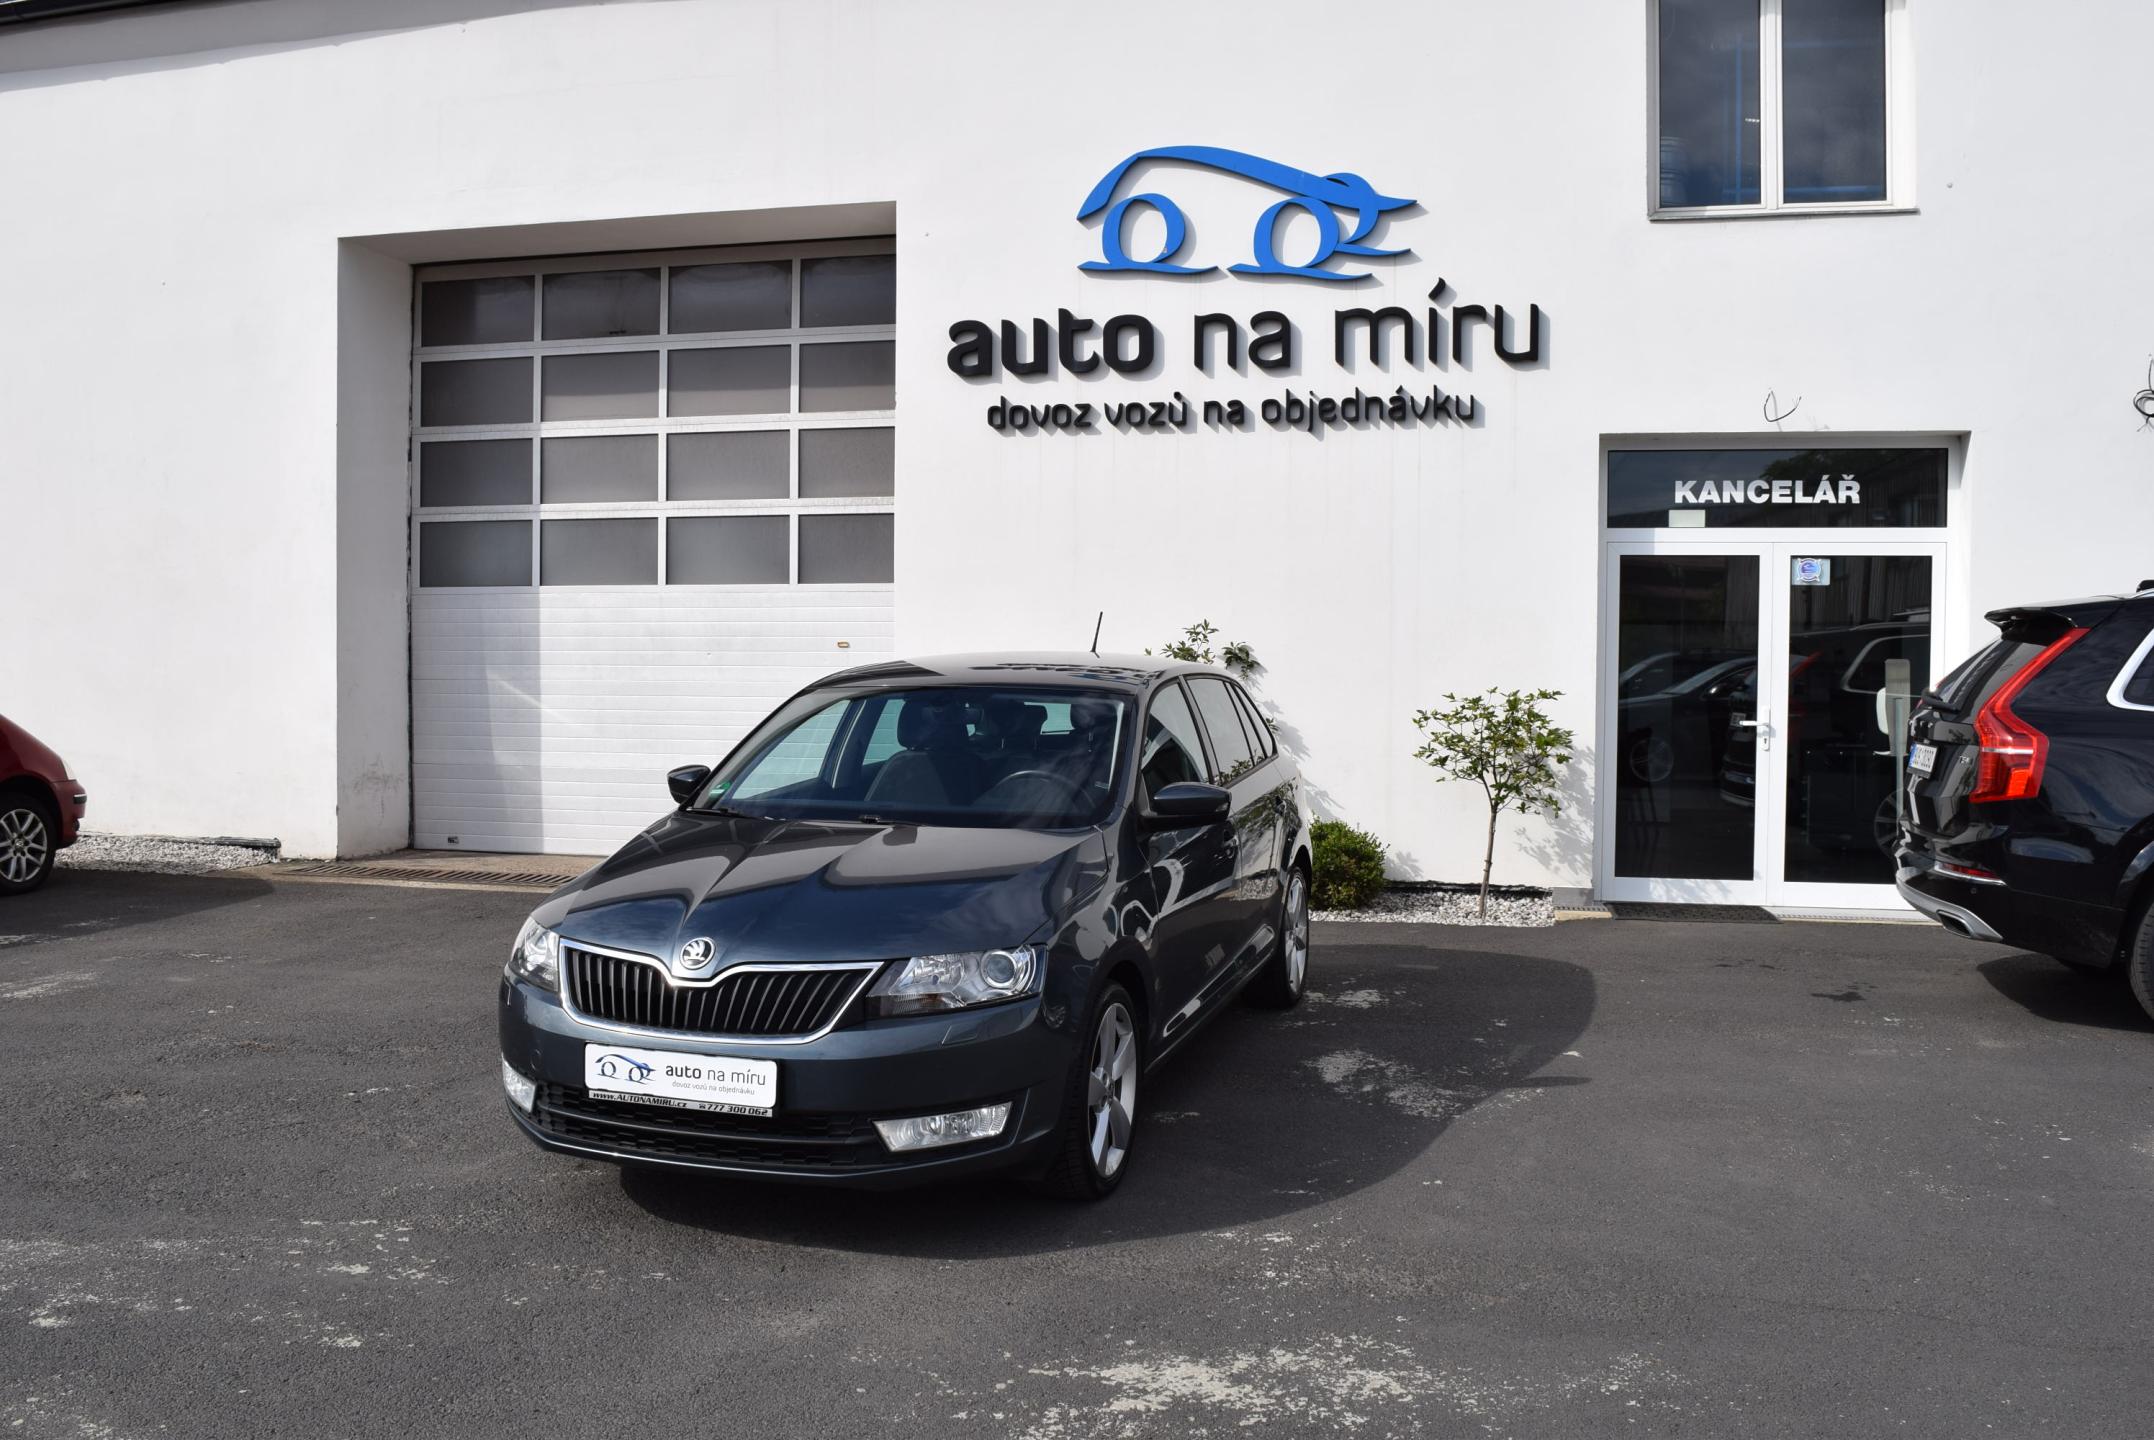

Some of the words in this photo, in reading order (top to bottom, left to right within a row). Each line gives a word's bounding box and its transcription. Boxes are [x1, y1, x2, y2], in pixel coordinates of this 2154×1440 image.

[947, 308, 1155, 379] auto
[1194, 310, 1292, 371] na
[1335, 279, 1540, 367] míru
[987, 396, 1092, 431] dovoz
[1104, 391, 1188, 428] vozů
[1203, 399, 1245, 426] na
[1261, 385, 1475, 433] objednávku
[1674, 474, 1861, 504] KANCELÁŘ
[665, 1064, 702, 1079] auto
[707, 1069, 725, 1082] na
[731, 1068, 766, 1086] míru
[727, 1105, 747, 1114] 300
[748, 1107, 768, 1116] 062
